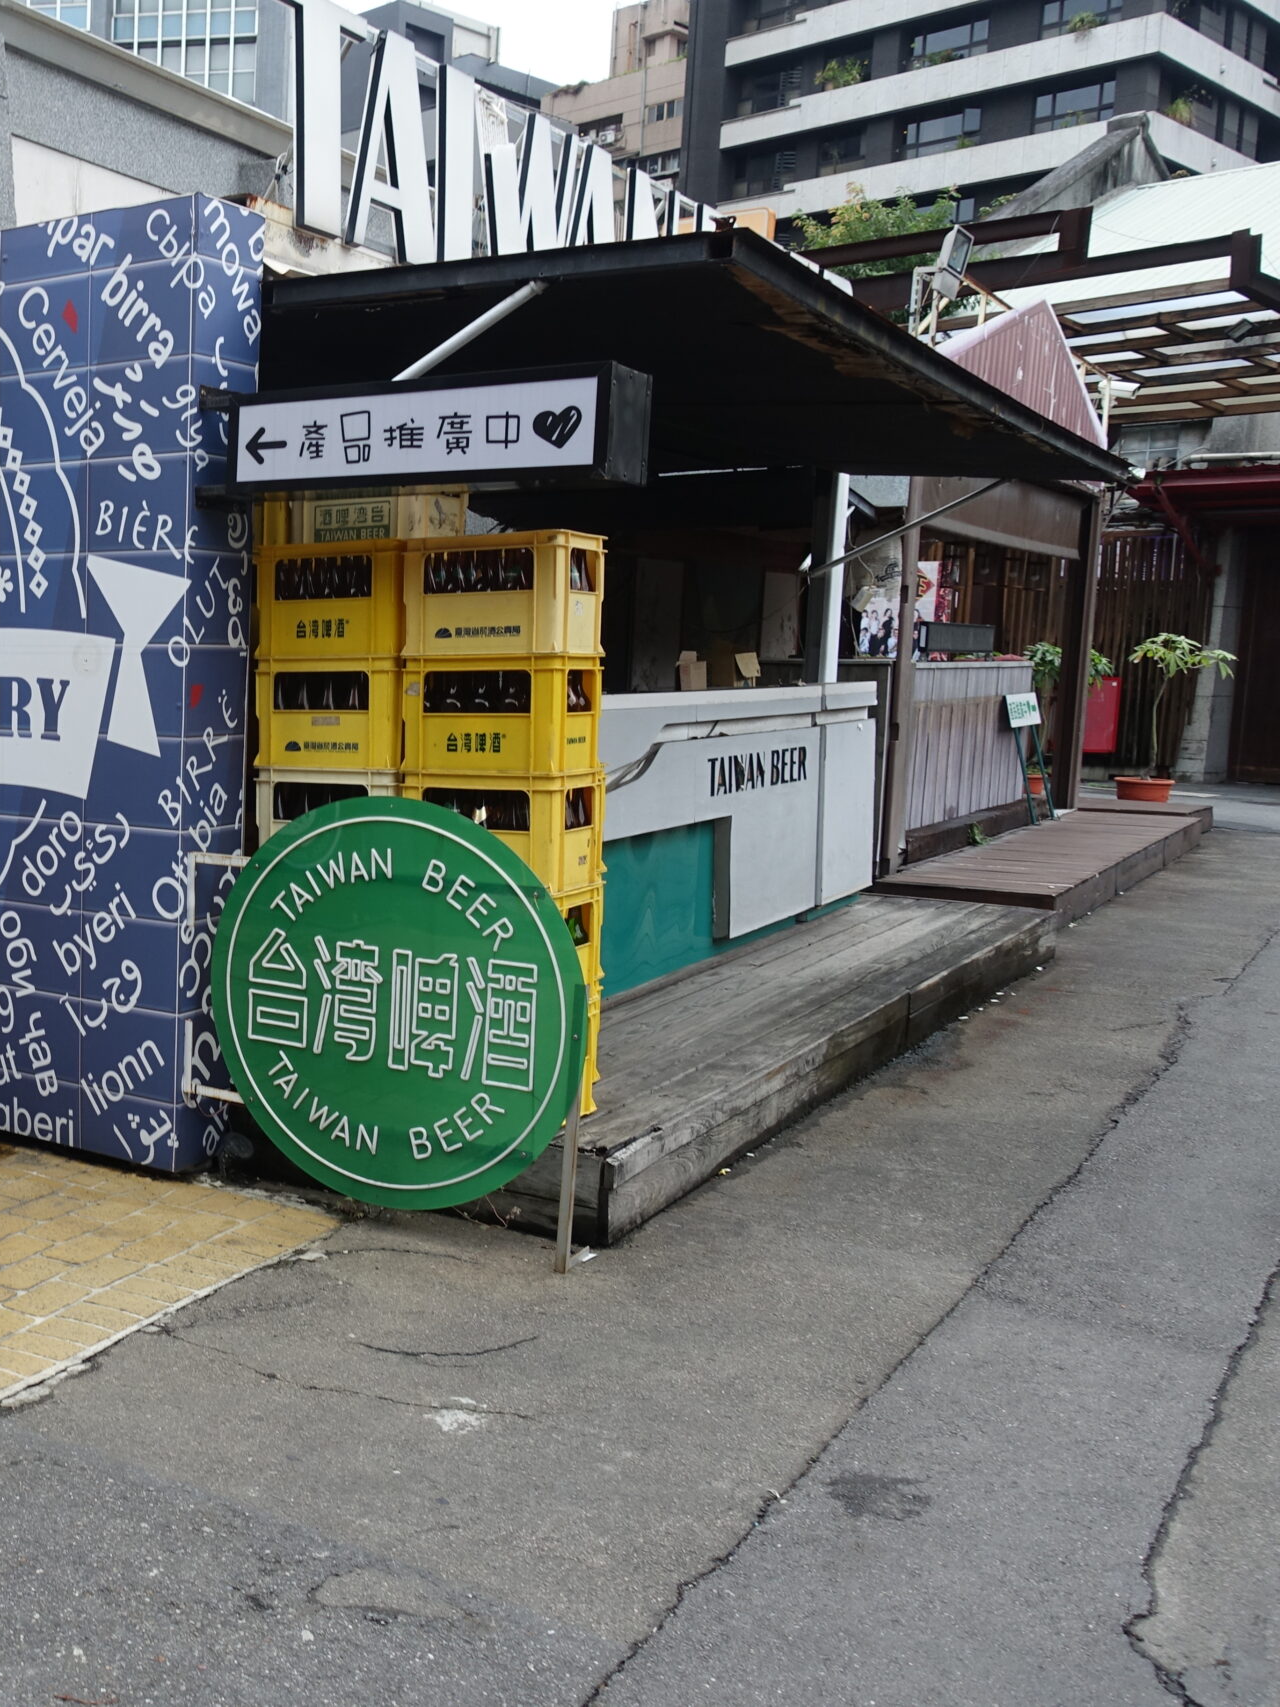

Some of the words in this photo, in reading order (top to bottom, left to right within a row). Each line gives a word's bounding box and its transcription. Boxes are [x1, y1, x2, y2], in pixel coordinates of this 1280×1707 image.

[101, 253, 174, 369] birra
[204, 200, 261, 346] mowa
[19, 286, 105, 458] Cerveja
[299, 411, 520, 464] 產品推廣中
[95, 500, 198, 564] BIÈRE
[320, 529, 358, 542] TAIWAN
[360, 527, 385, 540] BEER
[168, 556, 229, 667] OLUT
[708, 752, 766, 797] TAIWAN
[770, 746, 807, 786] BEER
[21, 811, 82, 896] doro
[189, 782, 228, 852] bia
[52, 882, 137, 976] byeri
[270, 848, 392, 921] TAIWAN
[422, 859, 514, 951] BEER
[80, 1039, 165, 1116] lionn
[268, 1050, 379, 1155] TAIWAN
[408, 1092, 506, 1160] BEER
